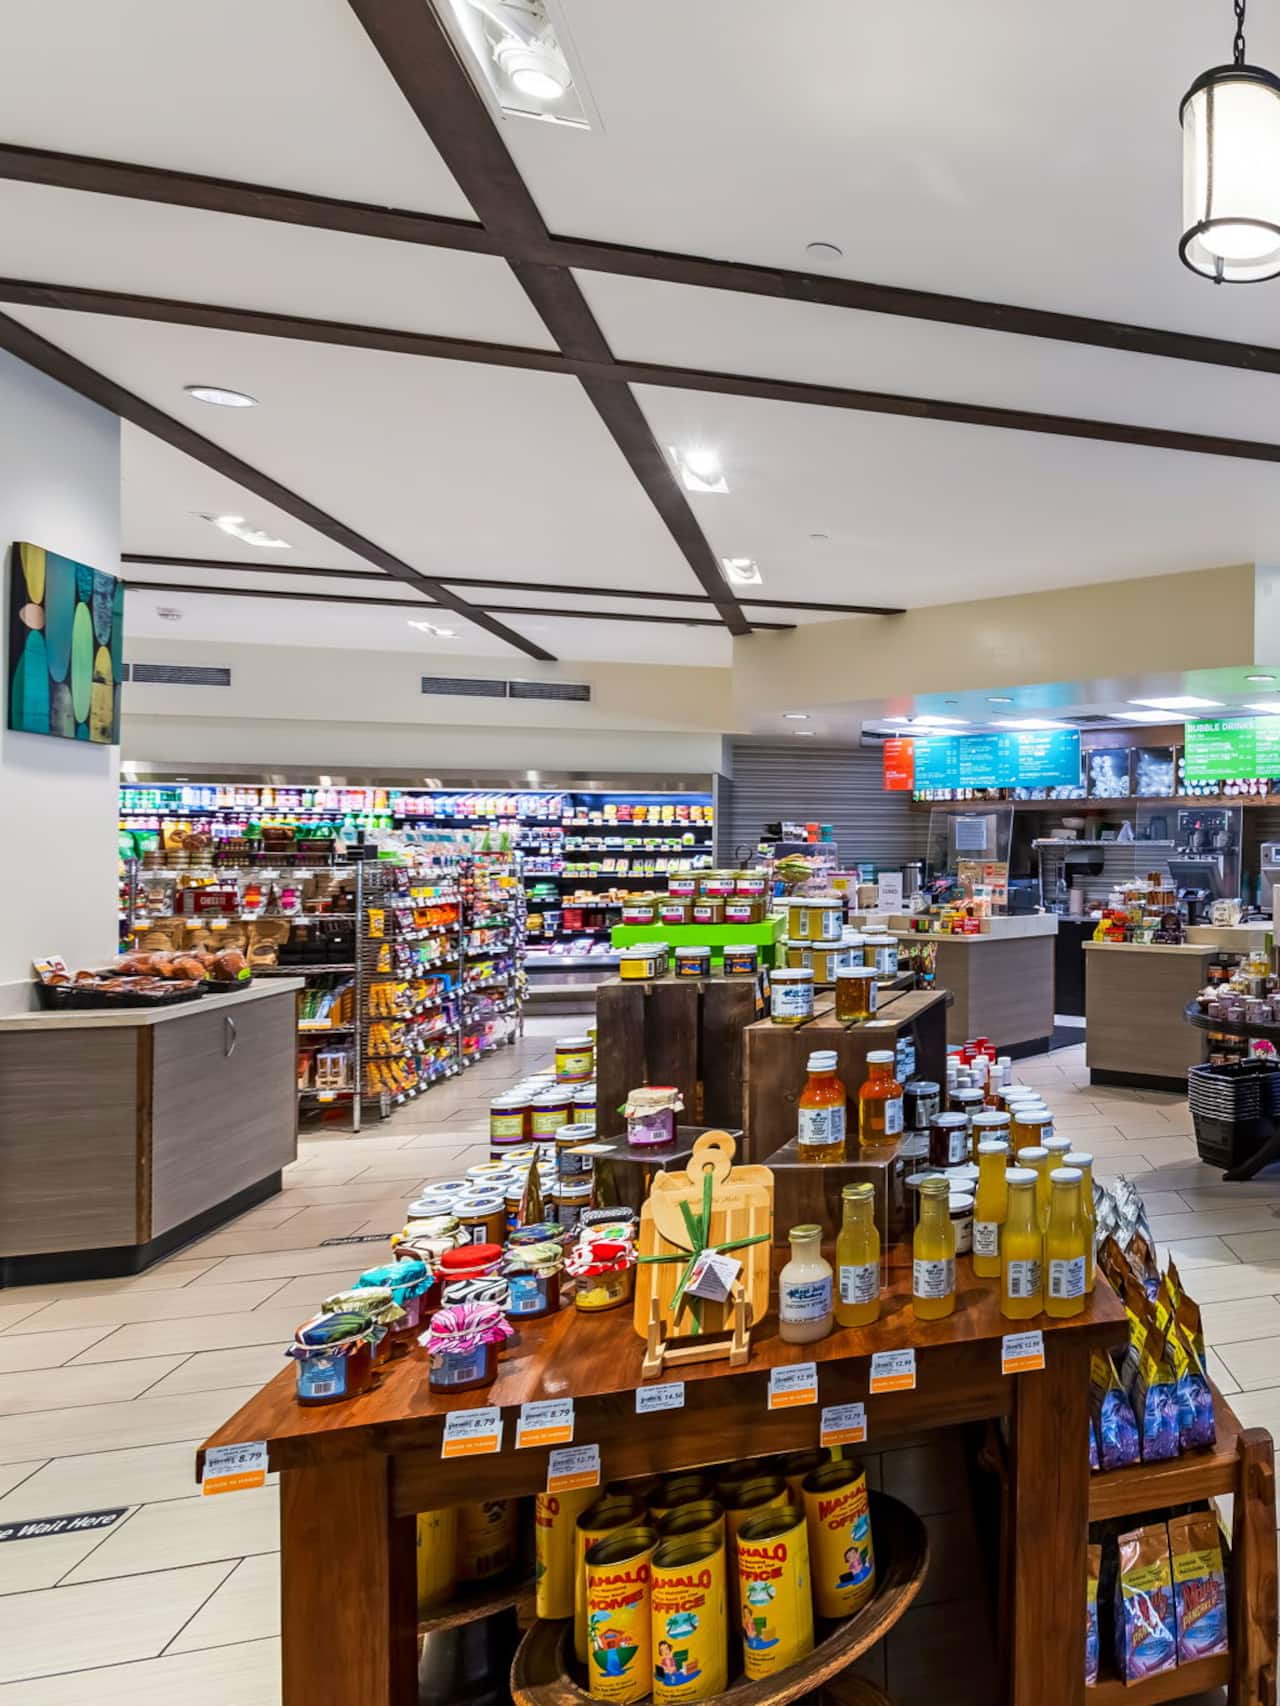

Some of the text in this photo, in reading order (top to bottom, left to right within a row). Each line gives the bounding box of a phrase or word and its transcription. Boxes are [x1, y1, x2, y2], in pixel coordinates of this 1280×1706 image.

[550, 1408, 570, 1418] 8.79
[473, 1417, 496, 1428] 8.79
[238, 1451, 262, 1463] 8.79
[818, 1481, 869, 1522] MAHAL
[17, 1520, 67, 1537] Wait
[65, 1514, 117, 1530] Here
